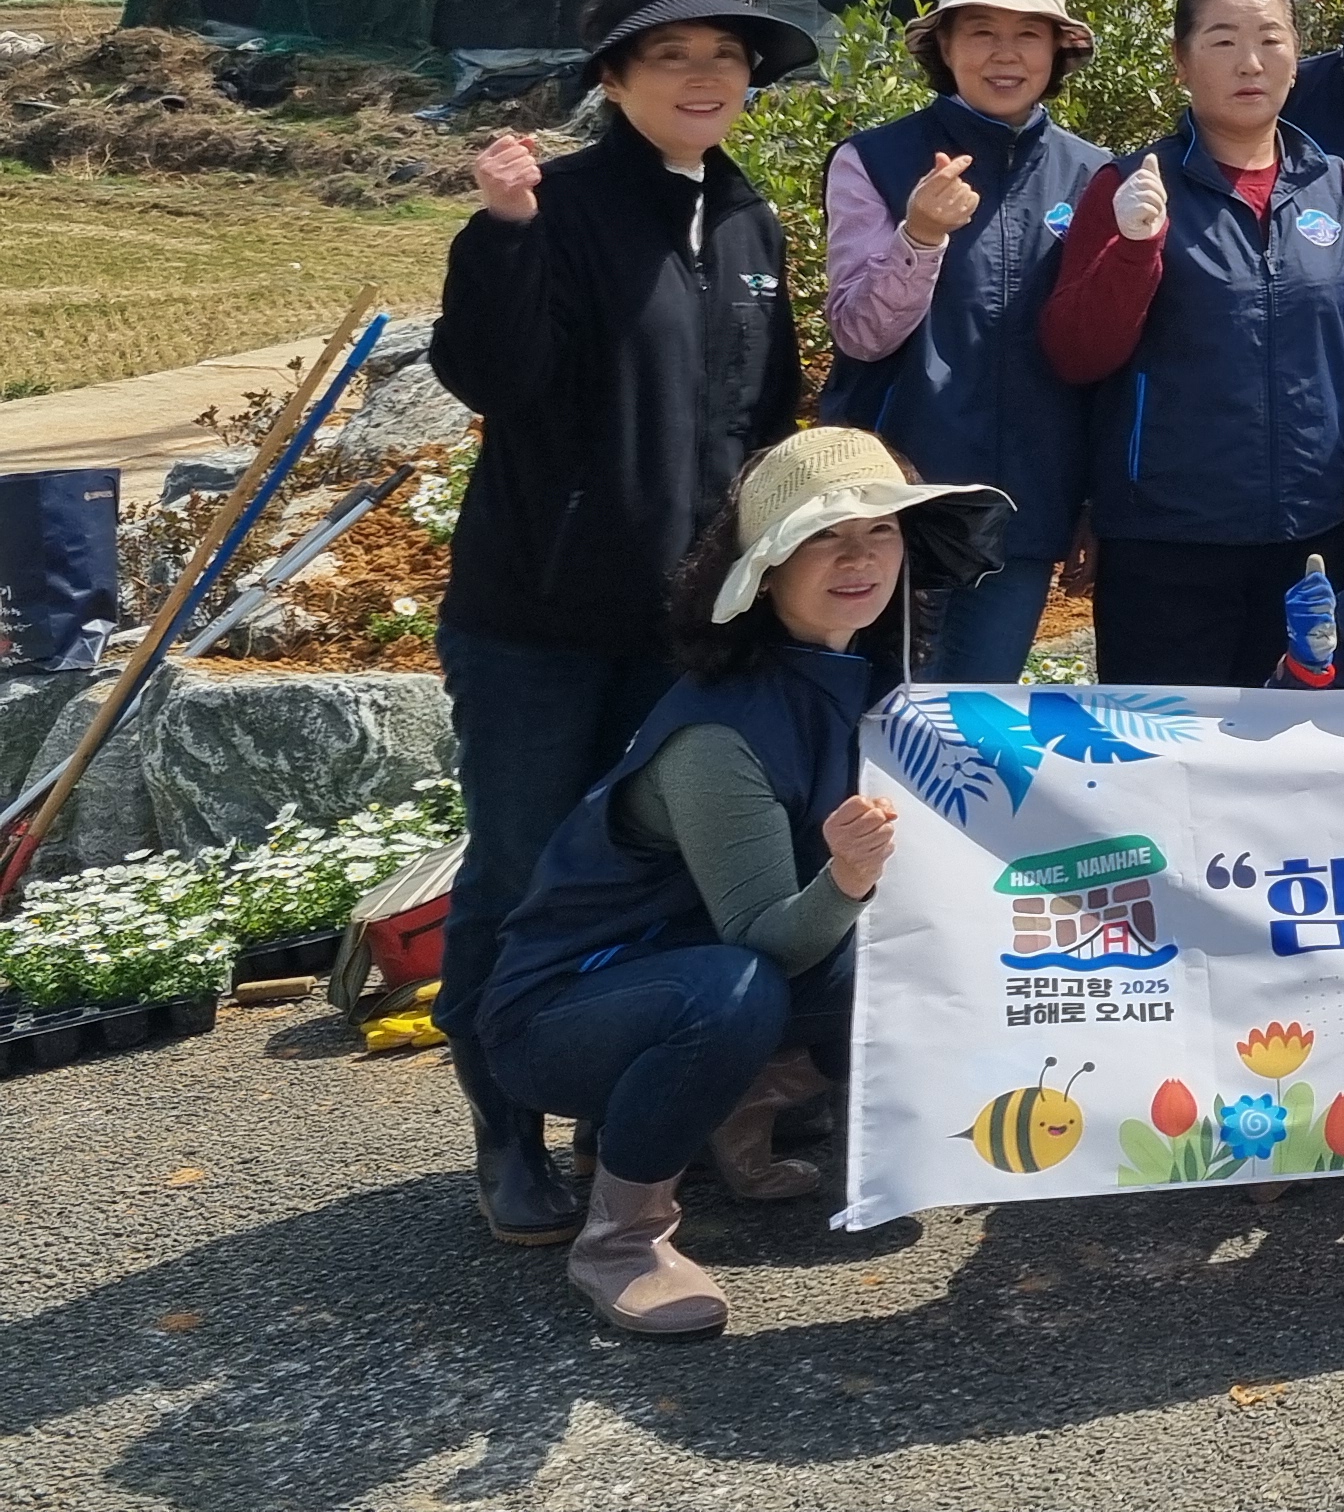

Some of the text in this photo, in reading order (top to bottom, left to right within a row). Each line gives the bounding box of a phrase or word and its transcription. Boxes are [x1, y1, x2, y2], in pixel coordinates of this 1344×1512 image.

[1010, 846, 1152, 888] HOME, NAMHAE
[1005, 977, 1170, 999] 국민고향 2025
[1006, 1001, 1175, 1027] 남해로 오시다
